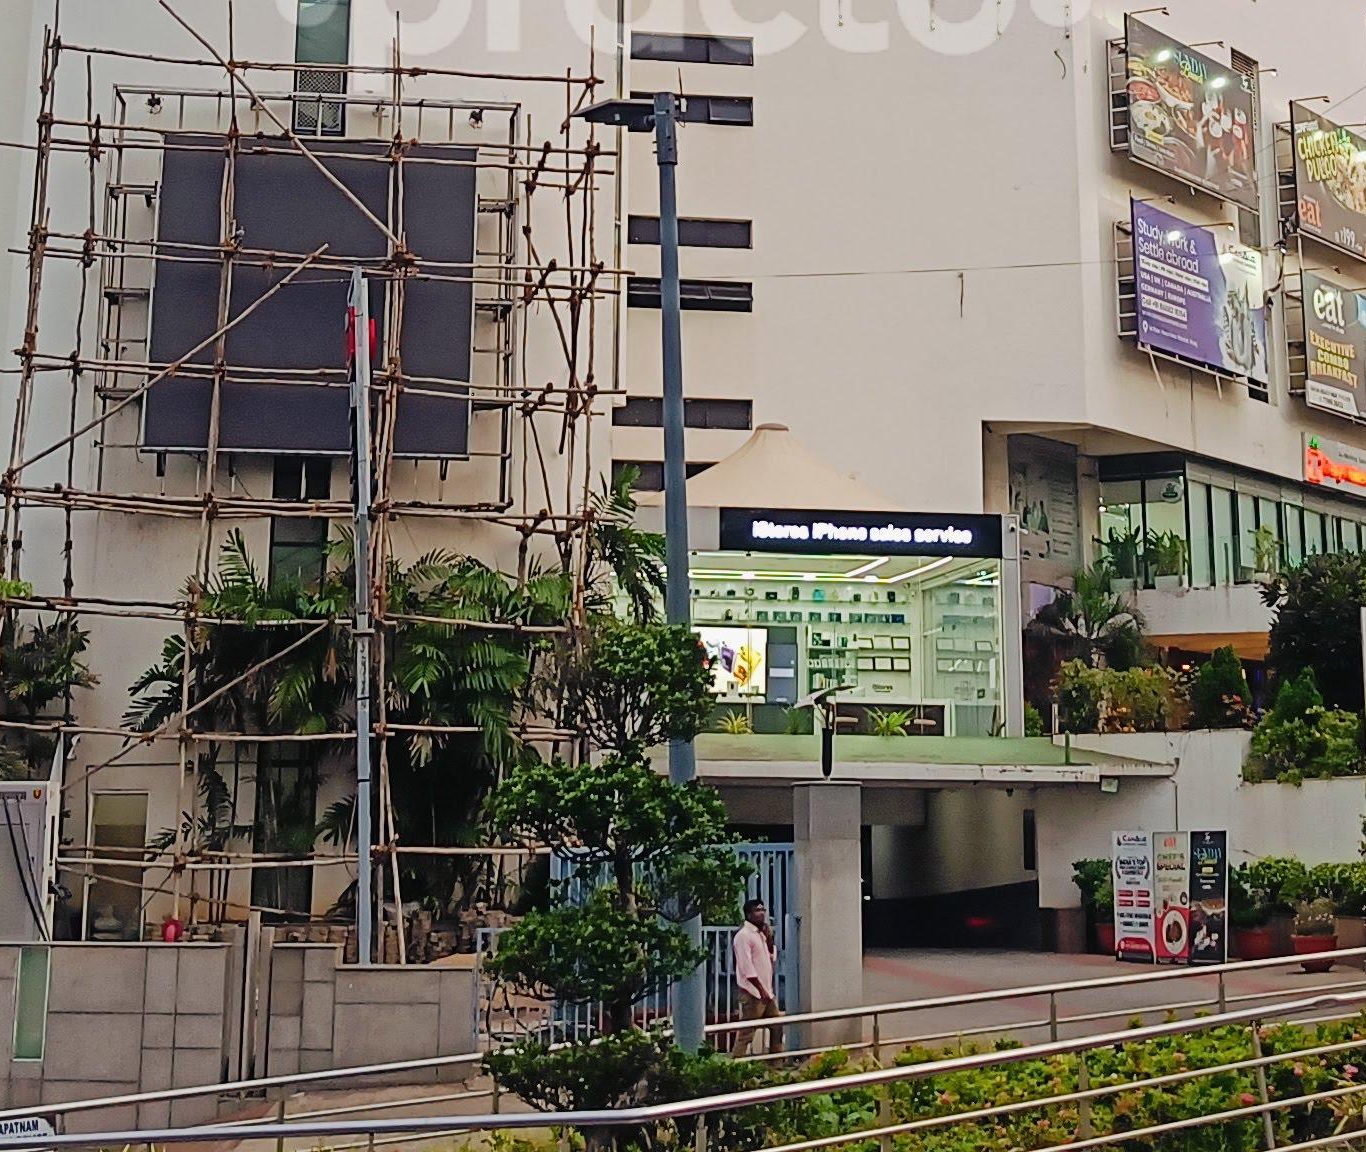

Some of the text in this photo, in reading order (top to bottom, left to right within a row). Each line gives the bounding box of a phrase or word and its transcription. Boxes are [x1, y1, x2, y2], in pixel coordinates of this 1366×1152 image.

[1138, 237, 1199, 273] Settle abroad
[1313, 288, 1345, 327] eat
[1309, 329, 1355, 359] EXECUTIVE
